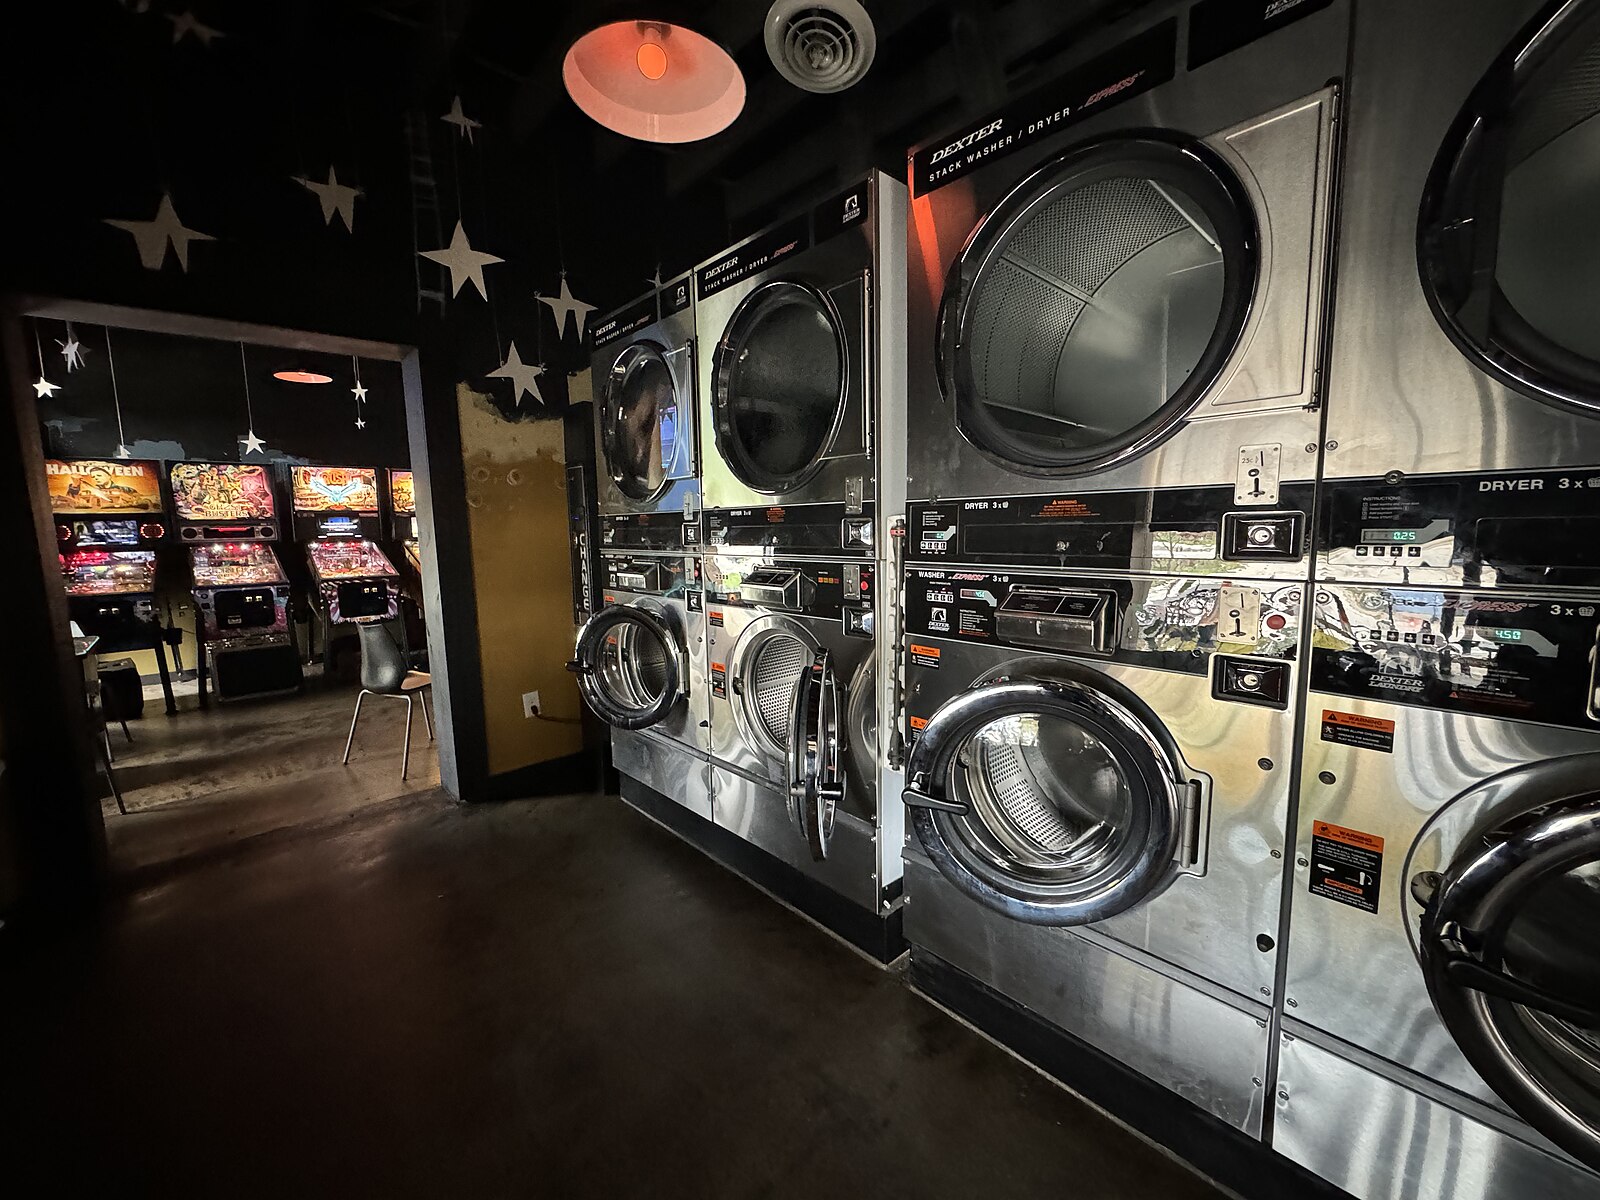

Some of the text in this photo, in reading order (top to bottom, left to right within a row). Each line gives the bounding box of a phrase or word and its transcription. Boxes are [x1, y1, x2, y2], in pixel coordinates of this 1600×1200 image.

[929, 118, 1003, 165] DEXTER
[929, 160, 962, 182] STACK
[966, 135, 1013, 164] WASHER
[1018, 130, 1023, 139] /
[1028, 107, 1070, 134] DRYER
[704, 256, 738, 280] DEXTER
[704, 279, 721, 292] STACK
[721, 268, 744, 283] WASHER
[749, 256, 768, 270] DRYER
[595, 321, 617, 337] DEXTER
[322, 471, 348, 484] RUSH
[1478, 478, 1583, 492] DRYER 3 x
[964, 502, 989, 510] DRYER
[579, 533, 590, 610] CHANGE
[918, 571, 945, 579] WASHER
[1550, 605, 1561, 616] 3
[1564, 607, 1574, 616] x
[1367, 680, 1425, 692] LAUNDRY
[1369, 674, 1423, 687] DEXTER
[1348, 716, 1383, 725] WARNING
[1338, 830, 1373, 843] WARNING
